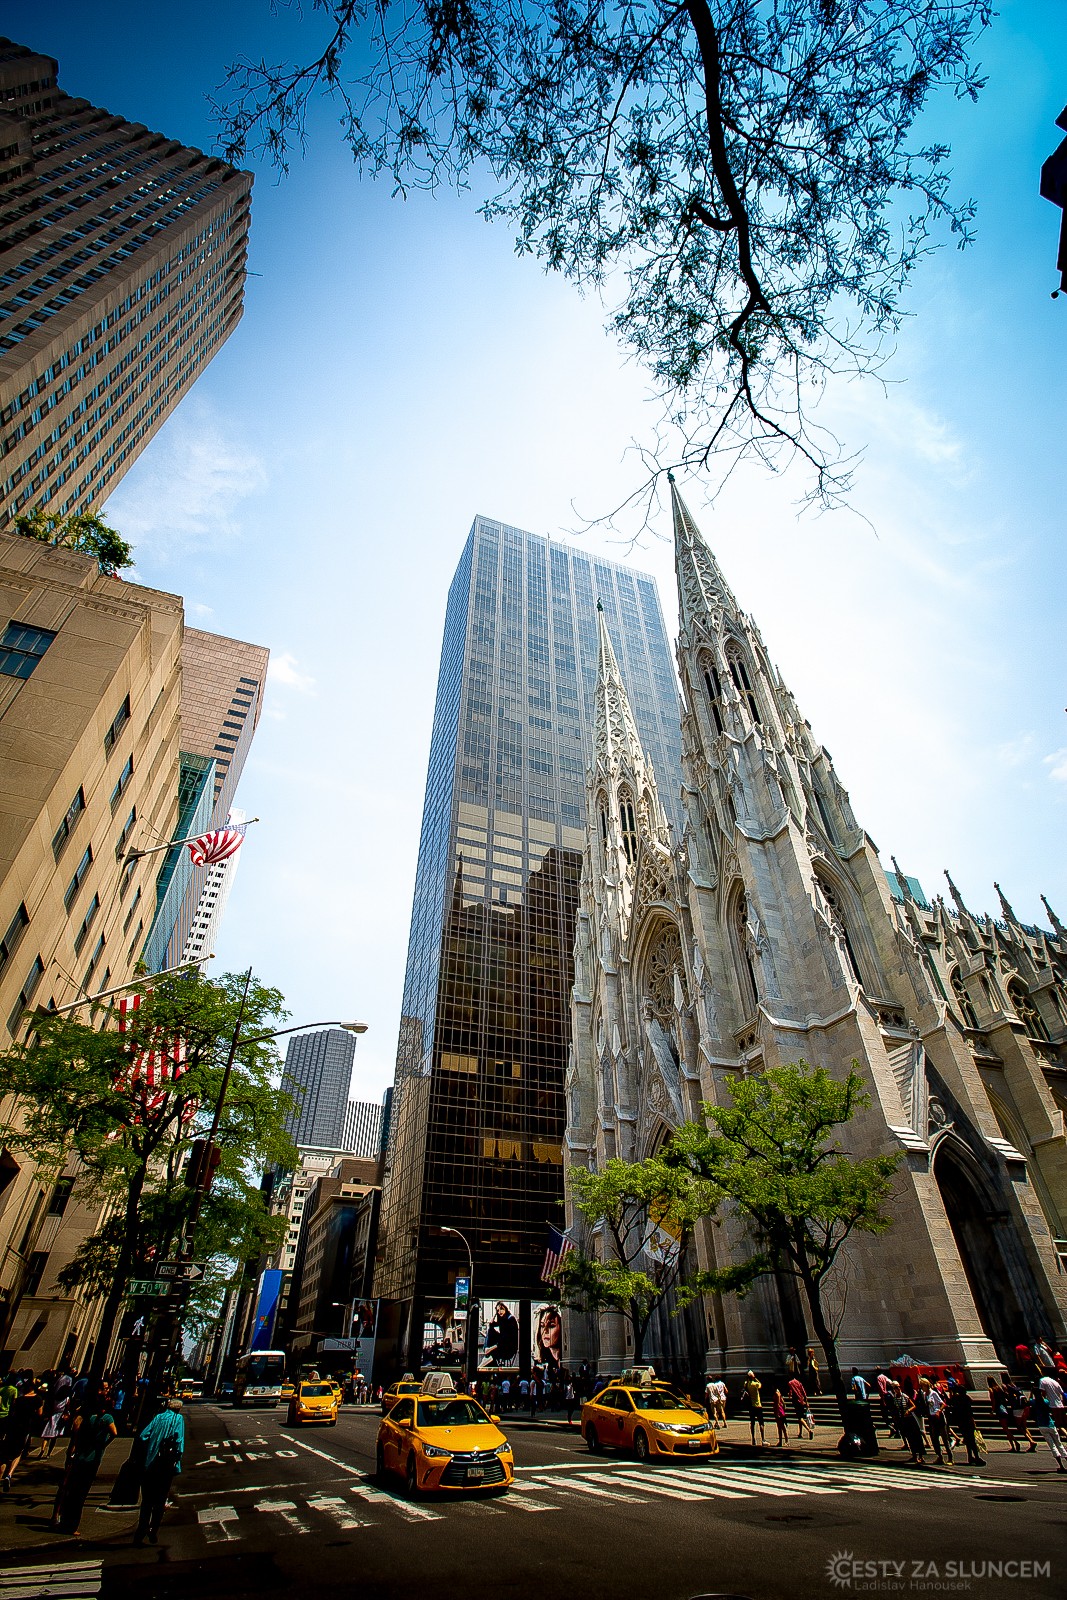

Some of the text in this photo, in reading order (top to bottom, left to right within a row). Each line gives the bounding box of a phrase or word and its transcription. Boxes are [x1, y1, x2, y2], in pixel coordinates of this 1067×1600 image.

[160, 1266, 176, 1274] ONE
[129, 1282, 138, 1292] W
[139, 1282, 153, 1294] 50
[204, 1438, 269, 1449] BUS
[195, 1450, 299, 1466] ONLY
